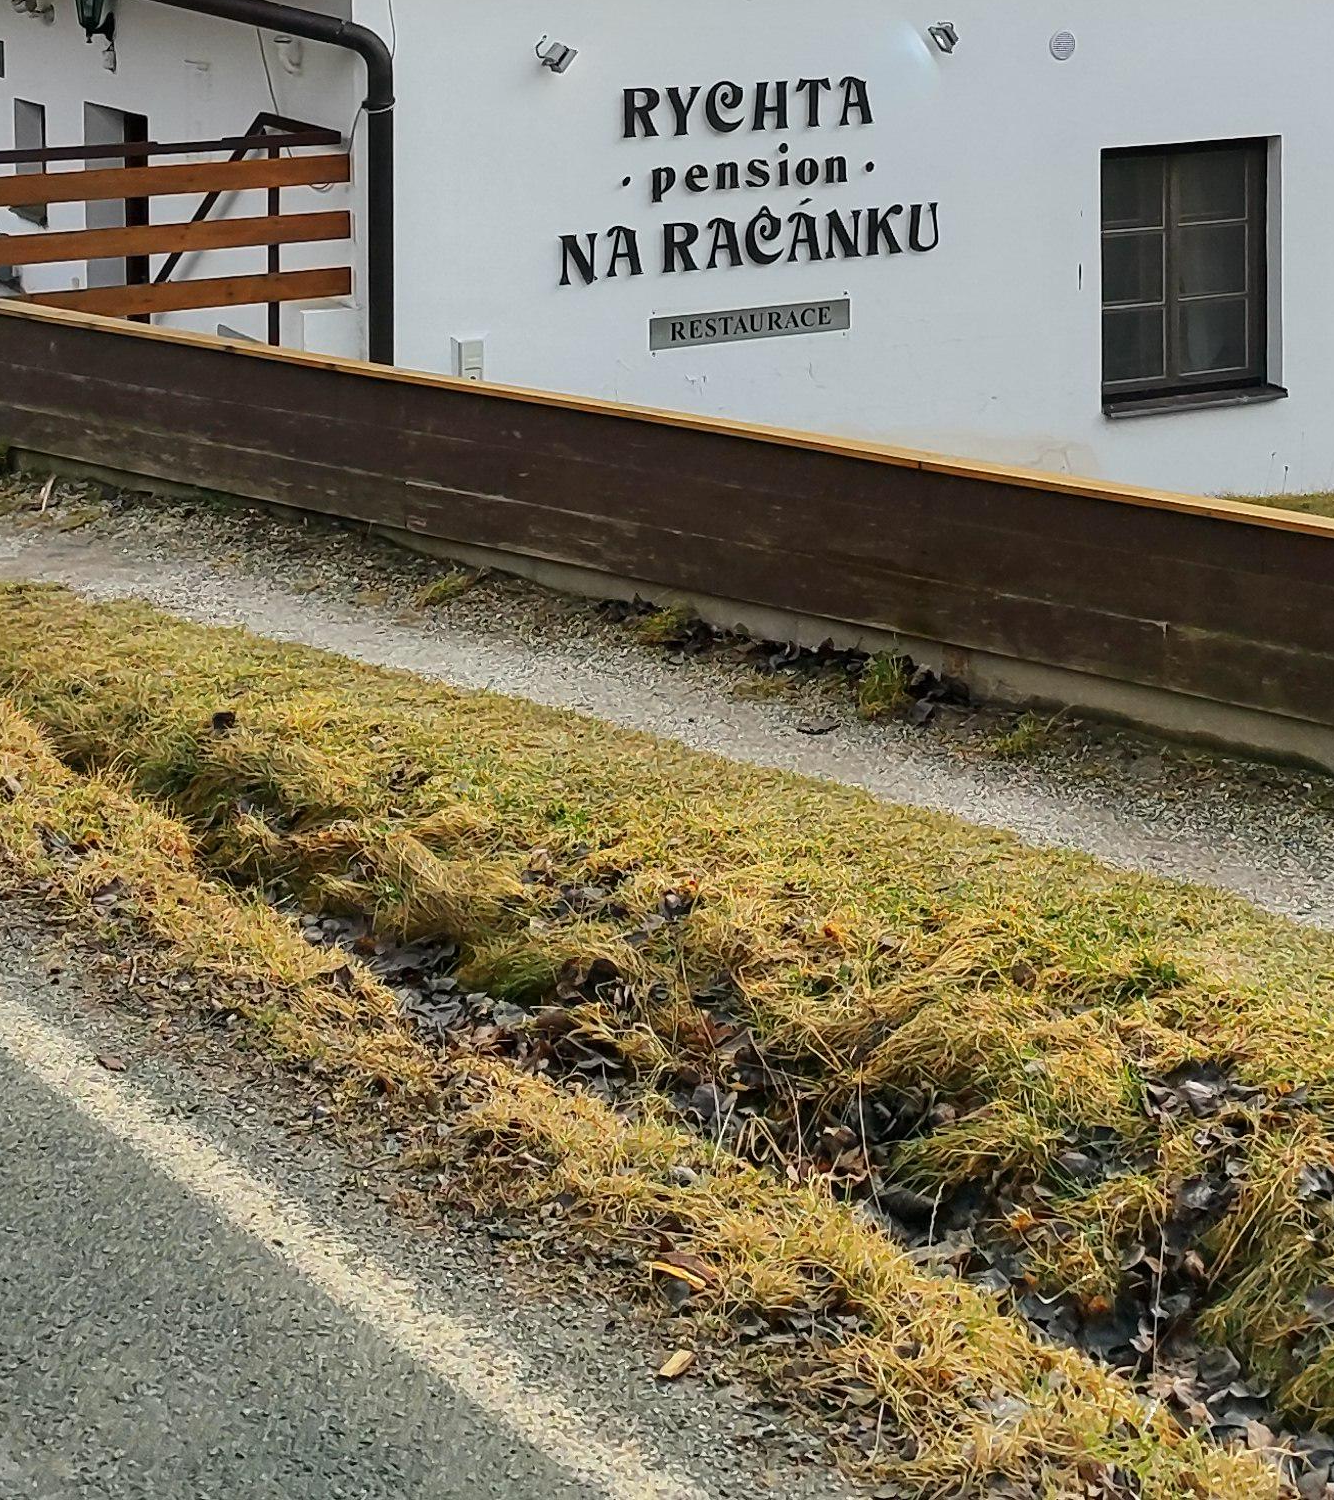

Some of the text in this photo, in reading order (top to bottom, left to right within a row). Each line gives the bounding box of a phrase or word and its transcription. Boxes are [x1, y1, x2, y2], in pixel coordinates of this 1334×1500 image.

[623, 76, 874, 139] RYCHTA
[651, 142, 848, 203] pension
[558, 225, 644, 286] NA
[670, 306, 832, 342] RESTAURACE
